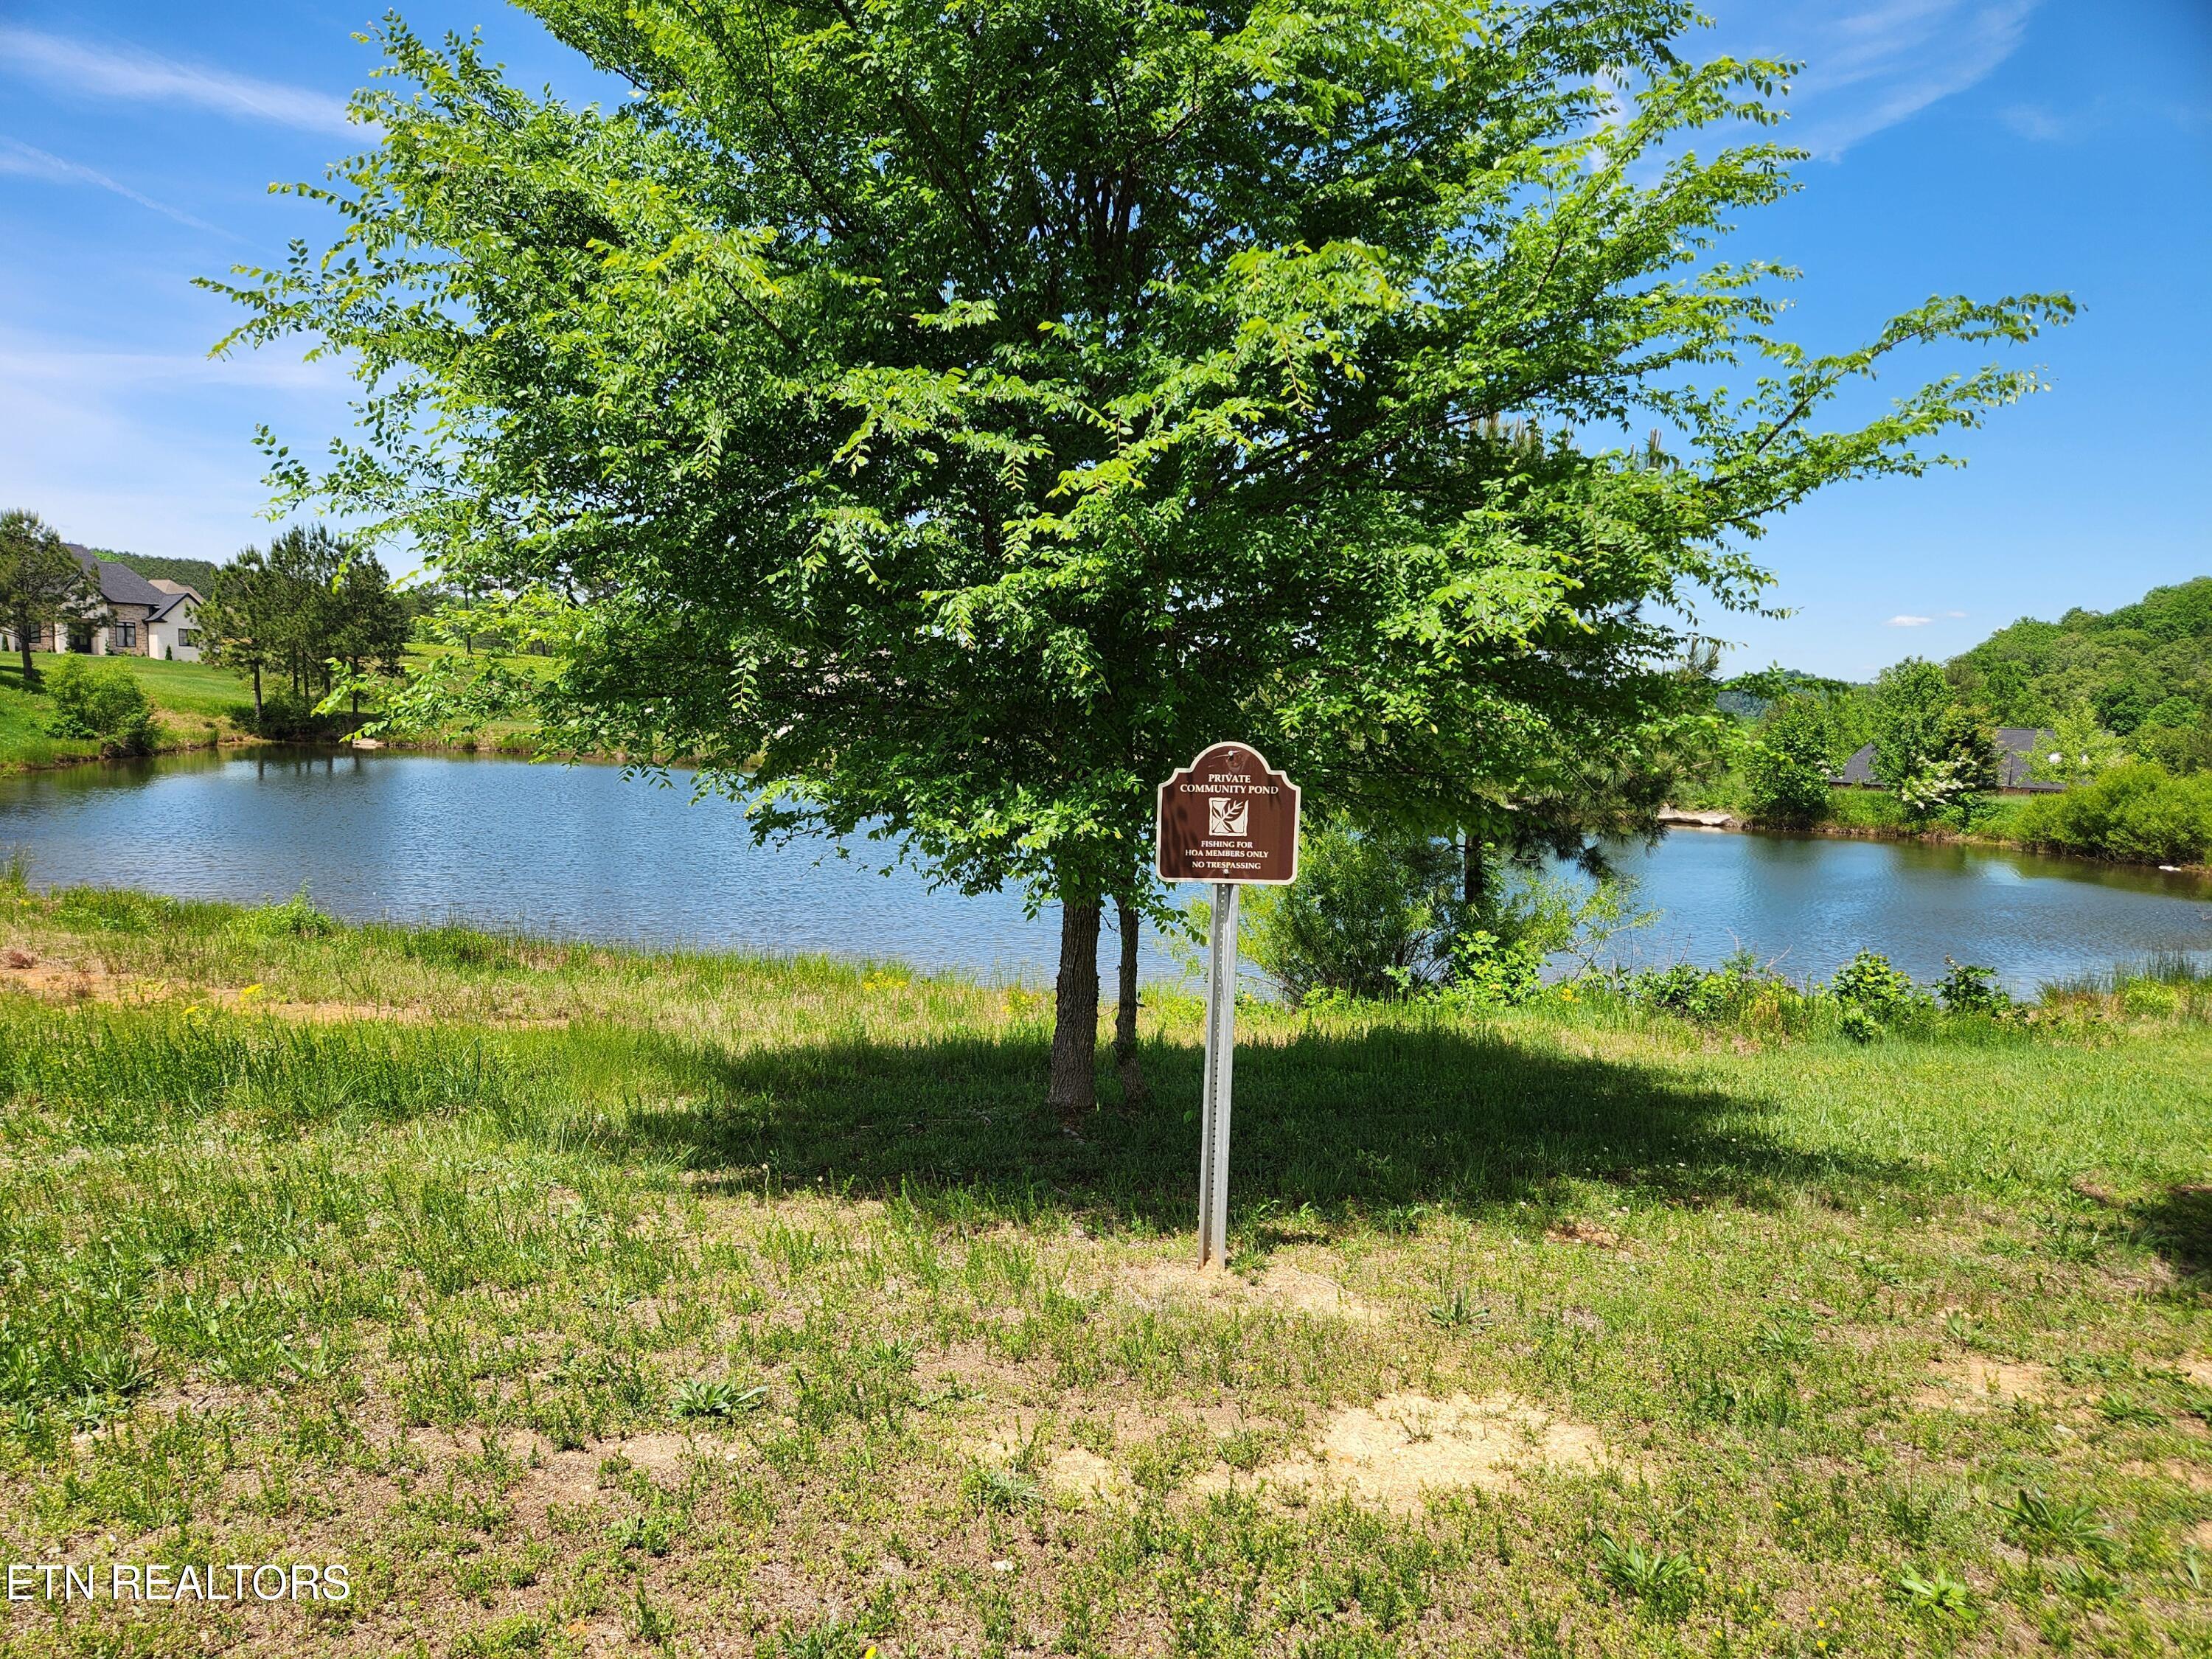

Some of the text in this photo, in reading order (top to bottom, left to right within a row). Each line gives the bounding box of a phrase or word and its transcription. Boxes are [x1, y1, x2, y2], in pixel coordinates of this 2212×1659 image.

[1208, 774, 1251, 783] PRIVATE
[1180, 784, 1279, 794] COMMUNITY POND
[1206, 861, 1261, 869] TRESPASSING
